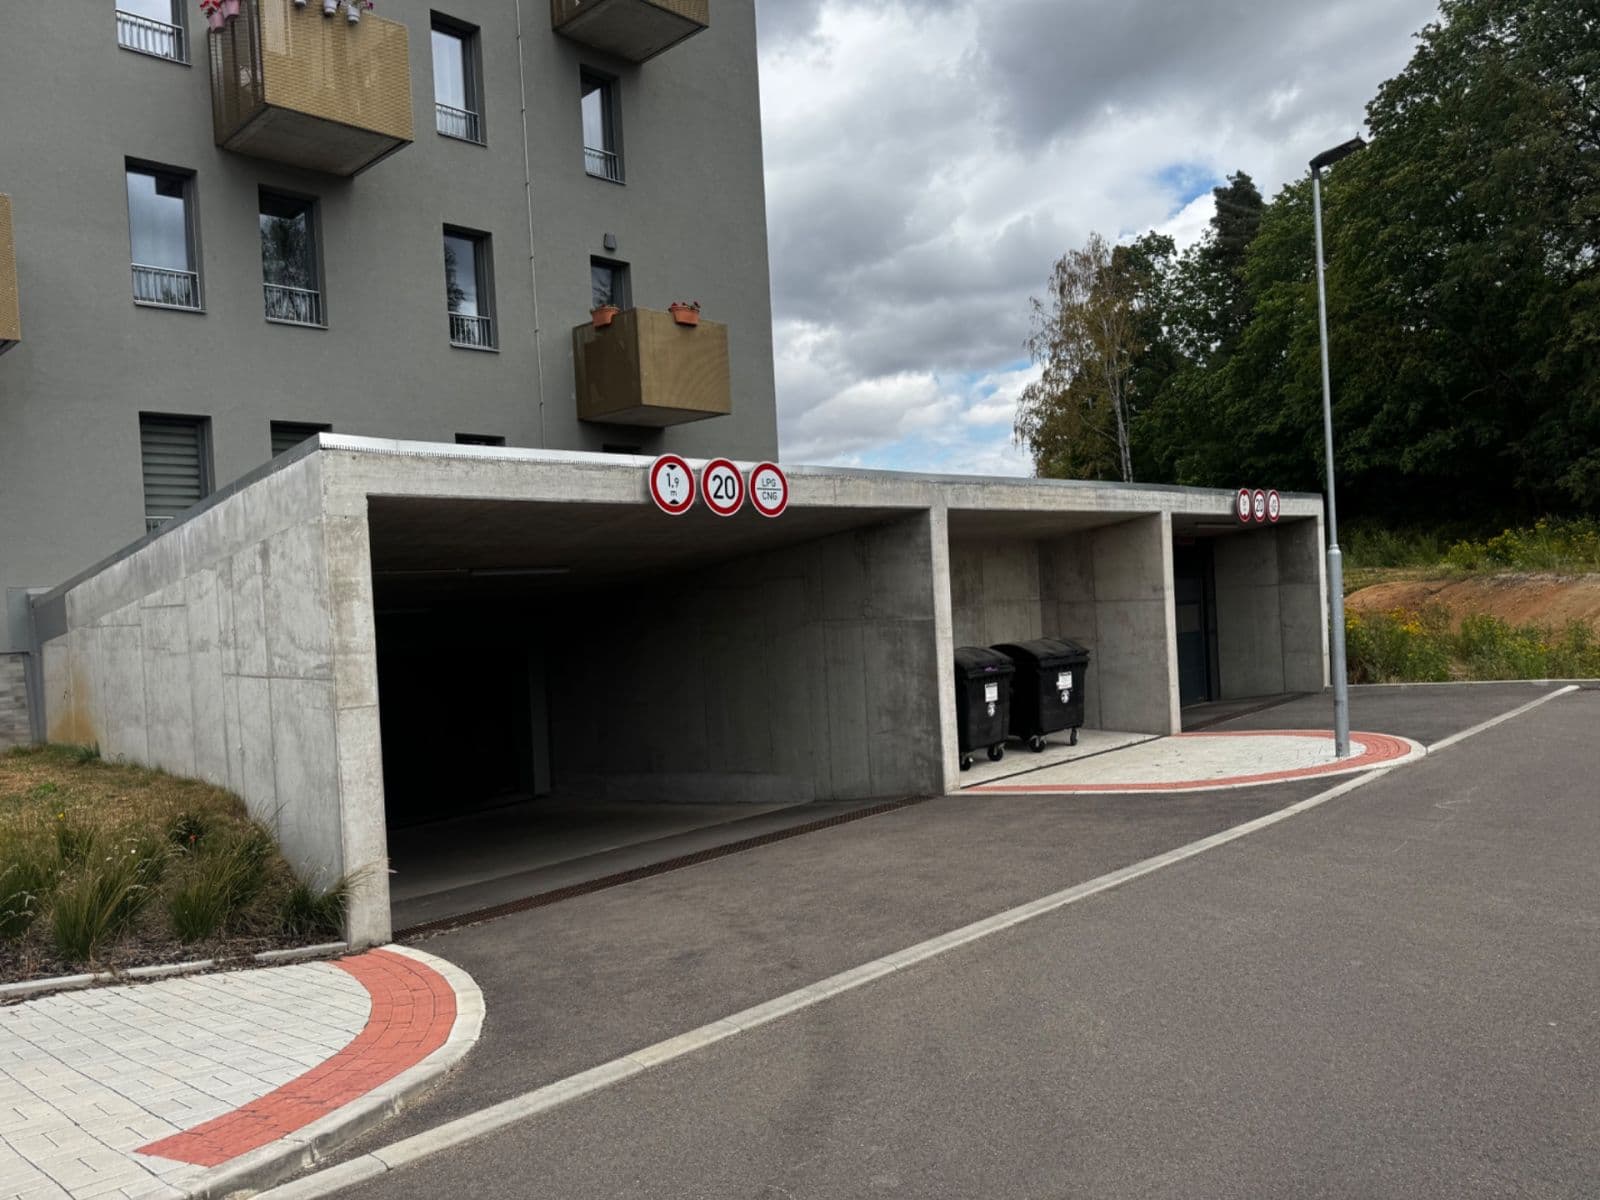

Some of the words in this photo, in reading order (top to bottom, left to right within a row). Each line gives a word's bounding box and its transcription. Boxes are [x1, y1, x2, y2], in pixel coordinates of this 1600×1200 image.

[712, 475, 736, 500] 20
[762, 478, 776, 488] LPG
[762, 491, 778, 501] CNG
